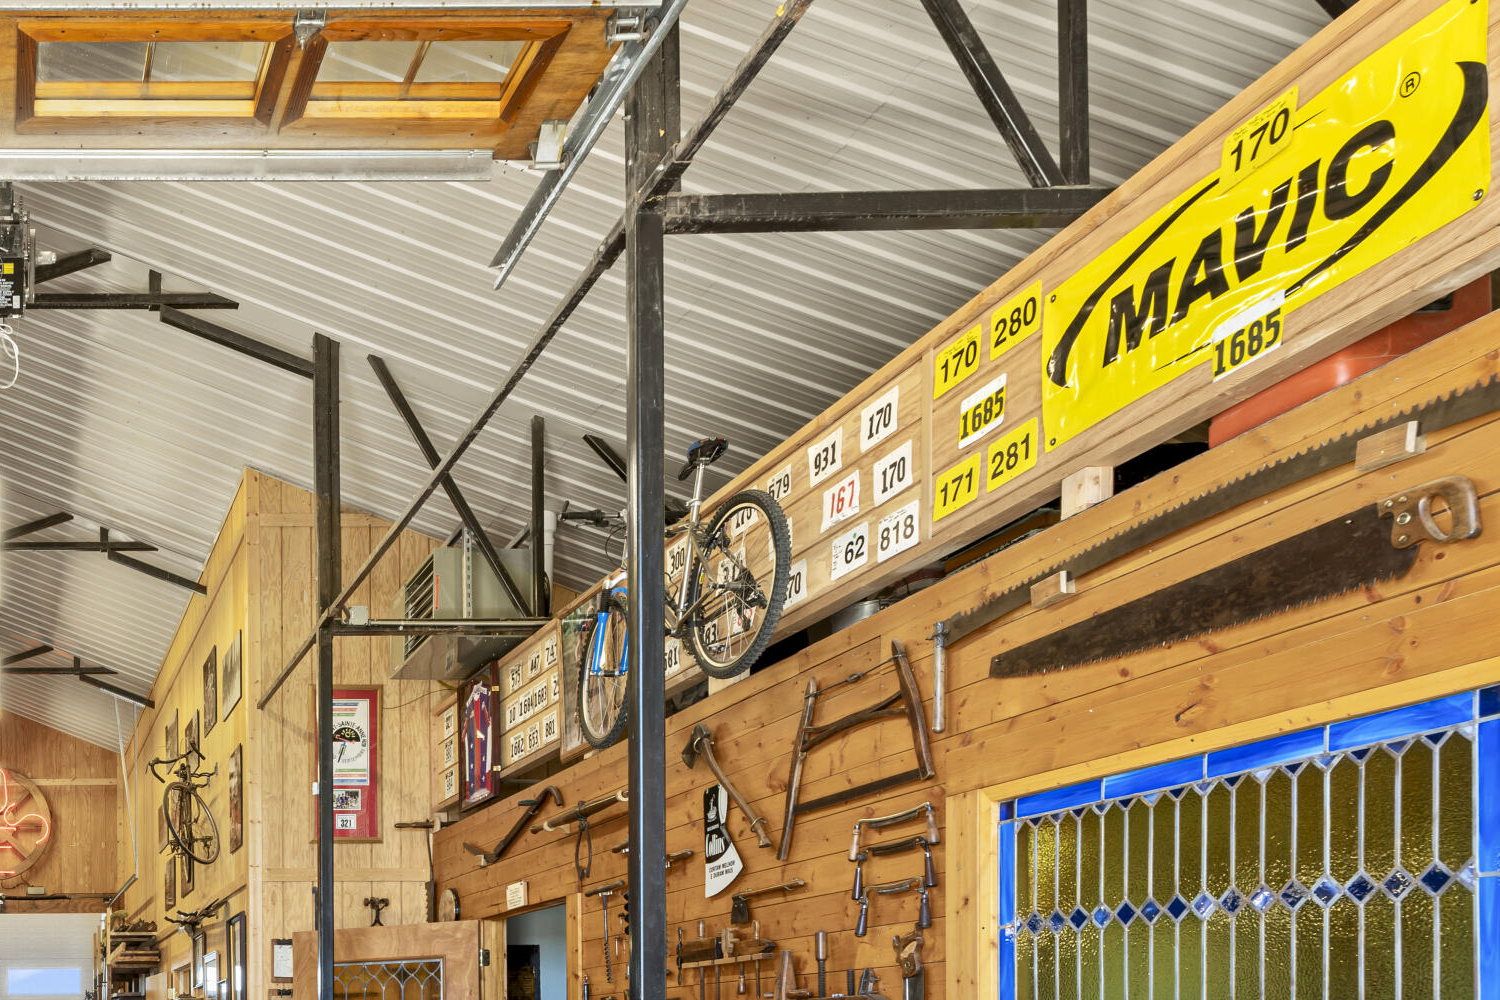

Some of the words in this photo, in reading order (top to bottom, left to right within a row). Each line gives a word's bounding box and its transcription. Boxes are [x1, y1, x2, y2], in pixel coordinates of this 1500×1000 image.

[1230, 107, 1290, 172] 170
[1103, 119, 1396, 369] MAVIC
[994, 296, 1037, 349] 280
[940, 340, 977, 384] 170
[1213, 308, 1282, 377] 1685
[867, 402, 892, 441] 170
[960, 387, 1004, 440] 1685
[814, 440, 837, 477] 931
[881, 456, 906, 495] 170
[991, 432, 1031, 481] 281
[769, 473, 790, 500] 579
[830, 479, 855, 519] 167
[940, 467, 974, 507] 171
[844, 535, 865, 565] 62
[880, 514, 915, 552] 818
[670, 548, 685, 575] 300
[788, 571, 801, 600] 70
[704, 623, 717, 645] 83
[340, 819, 352, 828] 321
